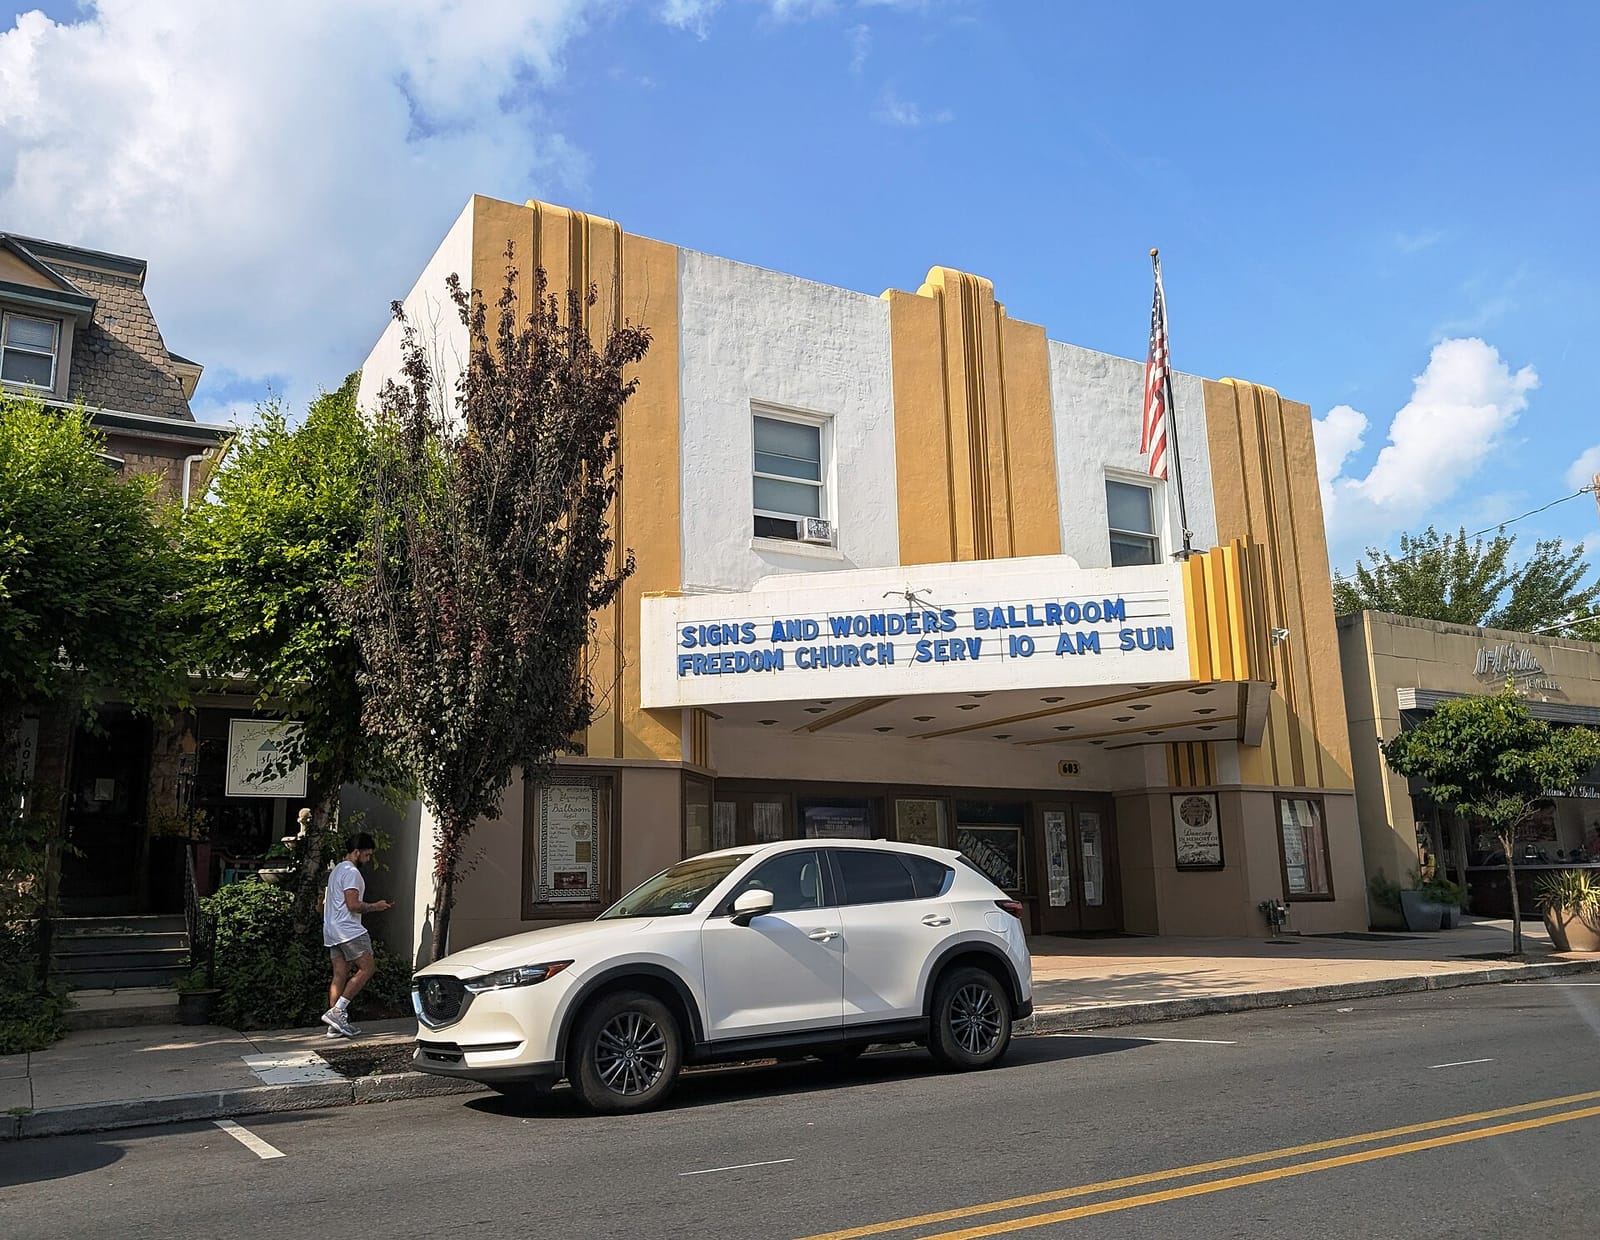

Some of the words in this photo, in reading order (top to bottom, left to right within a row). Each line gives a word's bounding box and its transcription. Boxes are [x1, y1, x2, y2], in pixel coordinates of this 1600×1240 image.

[681, 621, 757, 649] SIGNS
[770, 620, 821, 643] AND
[828, 609, 957, 640] WONDERS
[973, 598, 1127, 631] BALLROOM
[678, 648, 784, 677] FREEDOM
[794, 641, 895, 670] CHURCH
[915, 635, 983, 663] SERV
[1008, 634, 1035, 658] 10
[1055, 630, 1101, 656] AM
[1119, 626, 1174, 652] SUN
[1062, 763, 1079, 774] 603
